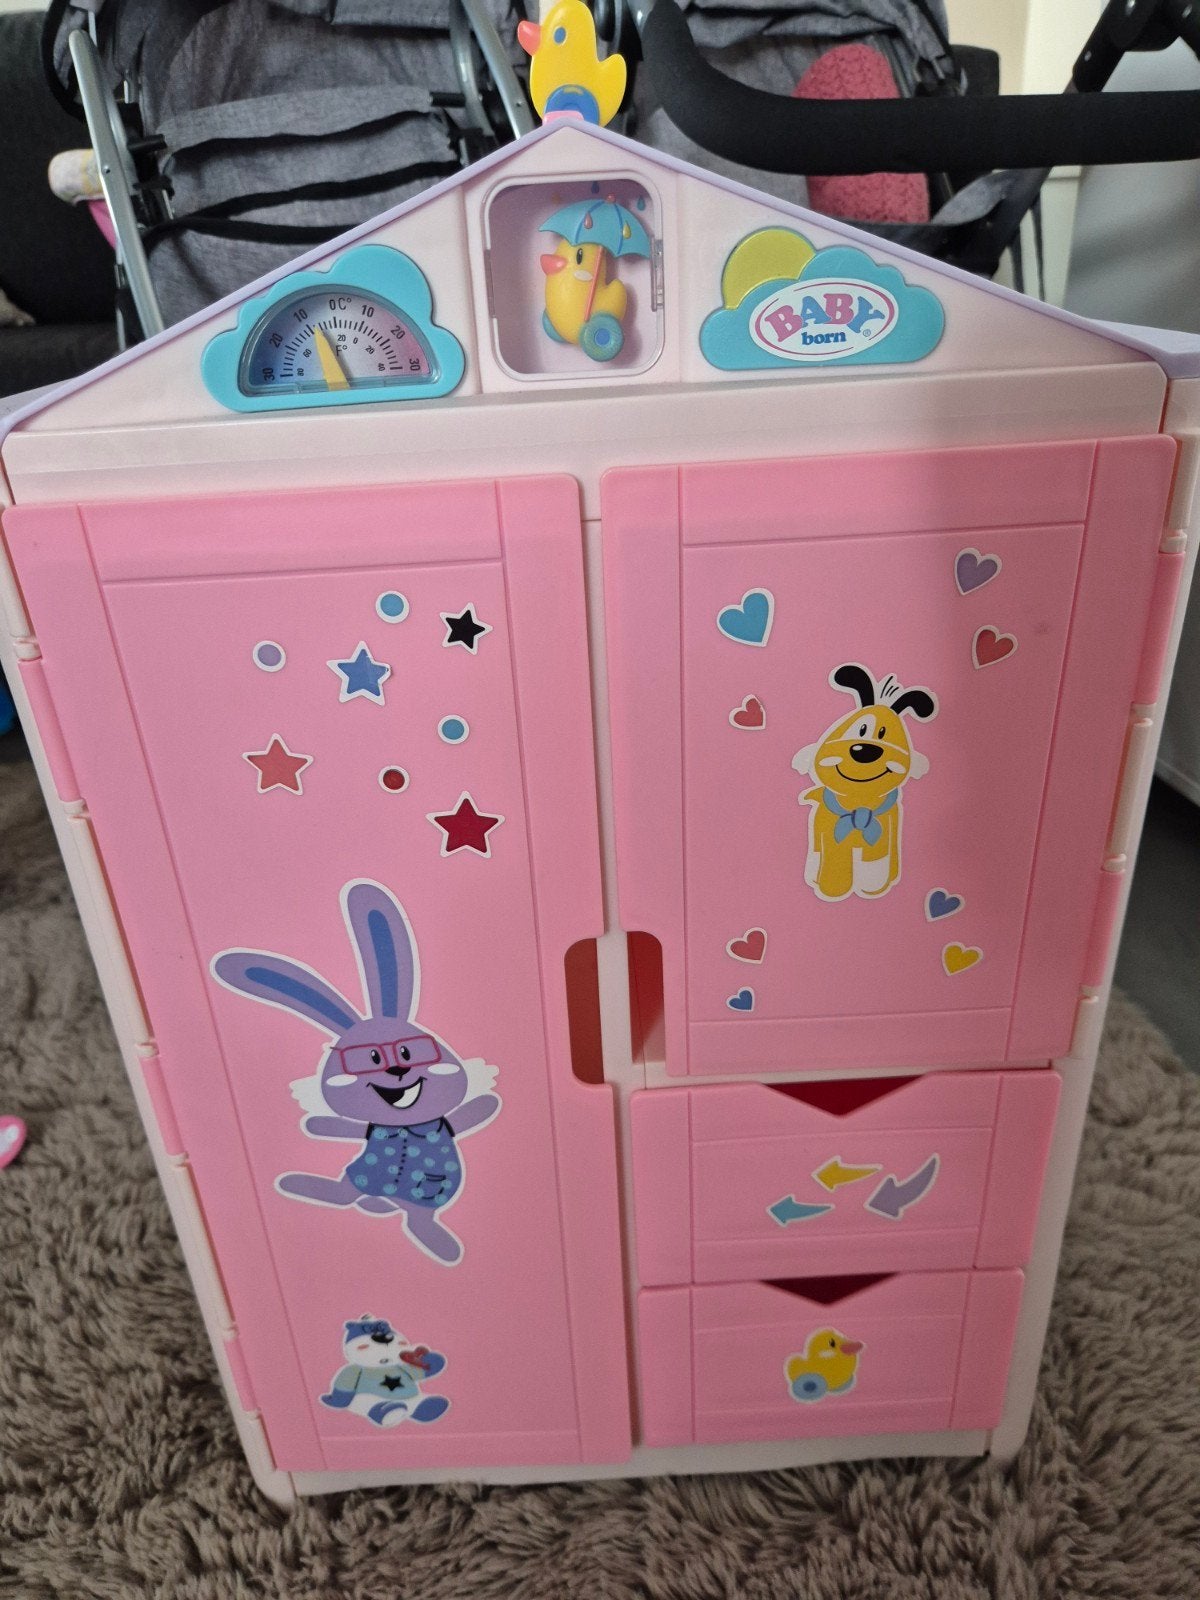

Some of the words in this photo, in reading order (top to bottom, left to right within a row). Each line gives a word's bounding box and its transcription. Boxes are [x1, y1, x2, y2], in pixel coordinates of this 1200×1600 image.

[294, 308, 308, 322] 10
[361, 304, 374, 318] 10
[764, 293, 885, 343] BABY
[337, 334, 346, 342] 20
[390, 325, 405, 340] 20
[801, 331, 846, 346] born
[269, 333, 283, 347] 20
[365, 345, 374, 355] 20
[377, 362, 386, 372] 40
[408, 358, 420, 371] 30
[262, 367, 275, 381] 30
